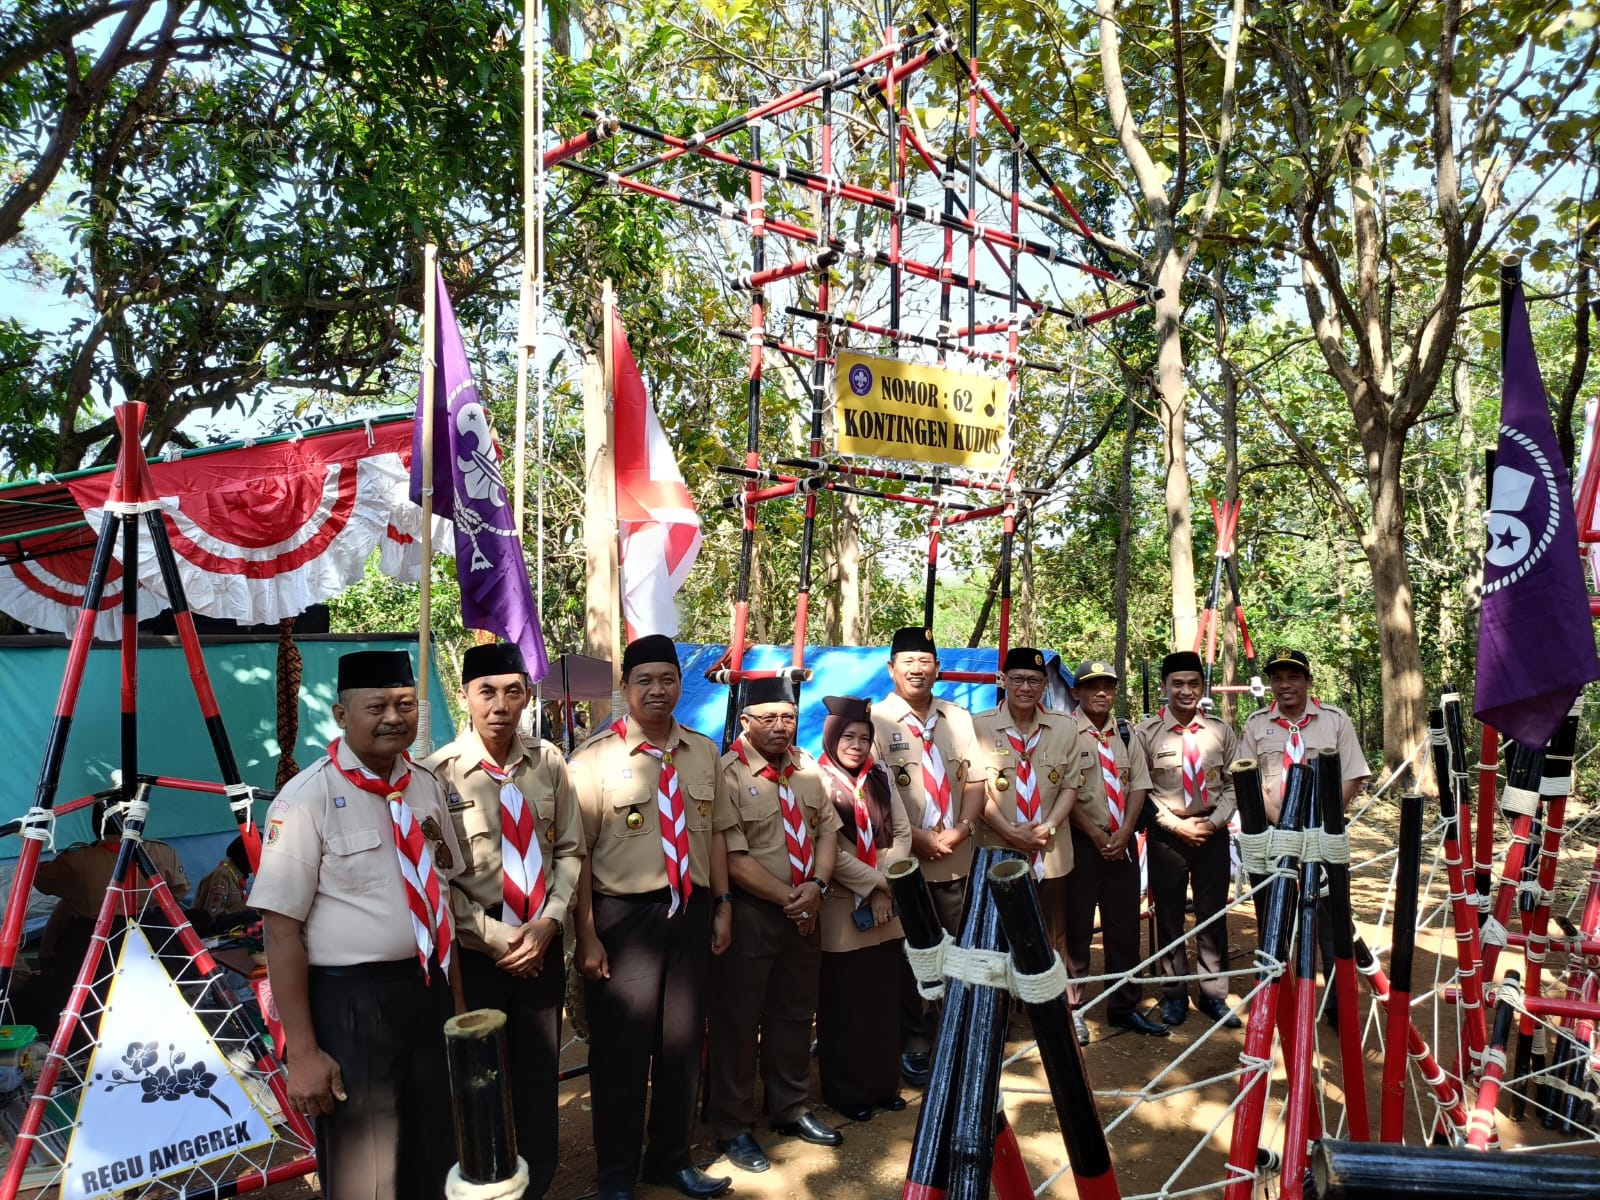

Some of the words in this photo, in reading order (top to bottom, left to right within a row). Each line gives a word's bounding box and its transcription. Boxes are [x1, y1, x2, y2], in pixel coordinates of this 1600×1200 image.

[881, 375, 938, 409] NOMOR
[953, 388, 973, 413] 62
[844, 408, 948, 449] KONTINGEN
[953, 423, 1001, 455] KUDUS
[81, 1155, 144, 1195] REGU
[150, 1120, 251, 1173] ANGGREK
